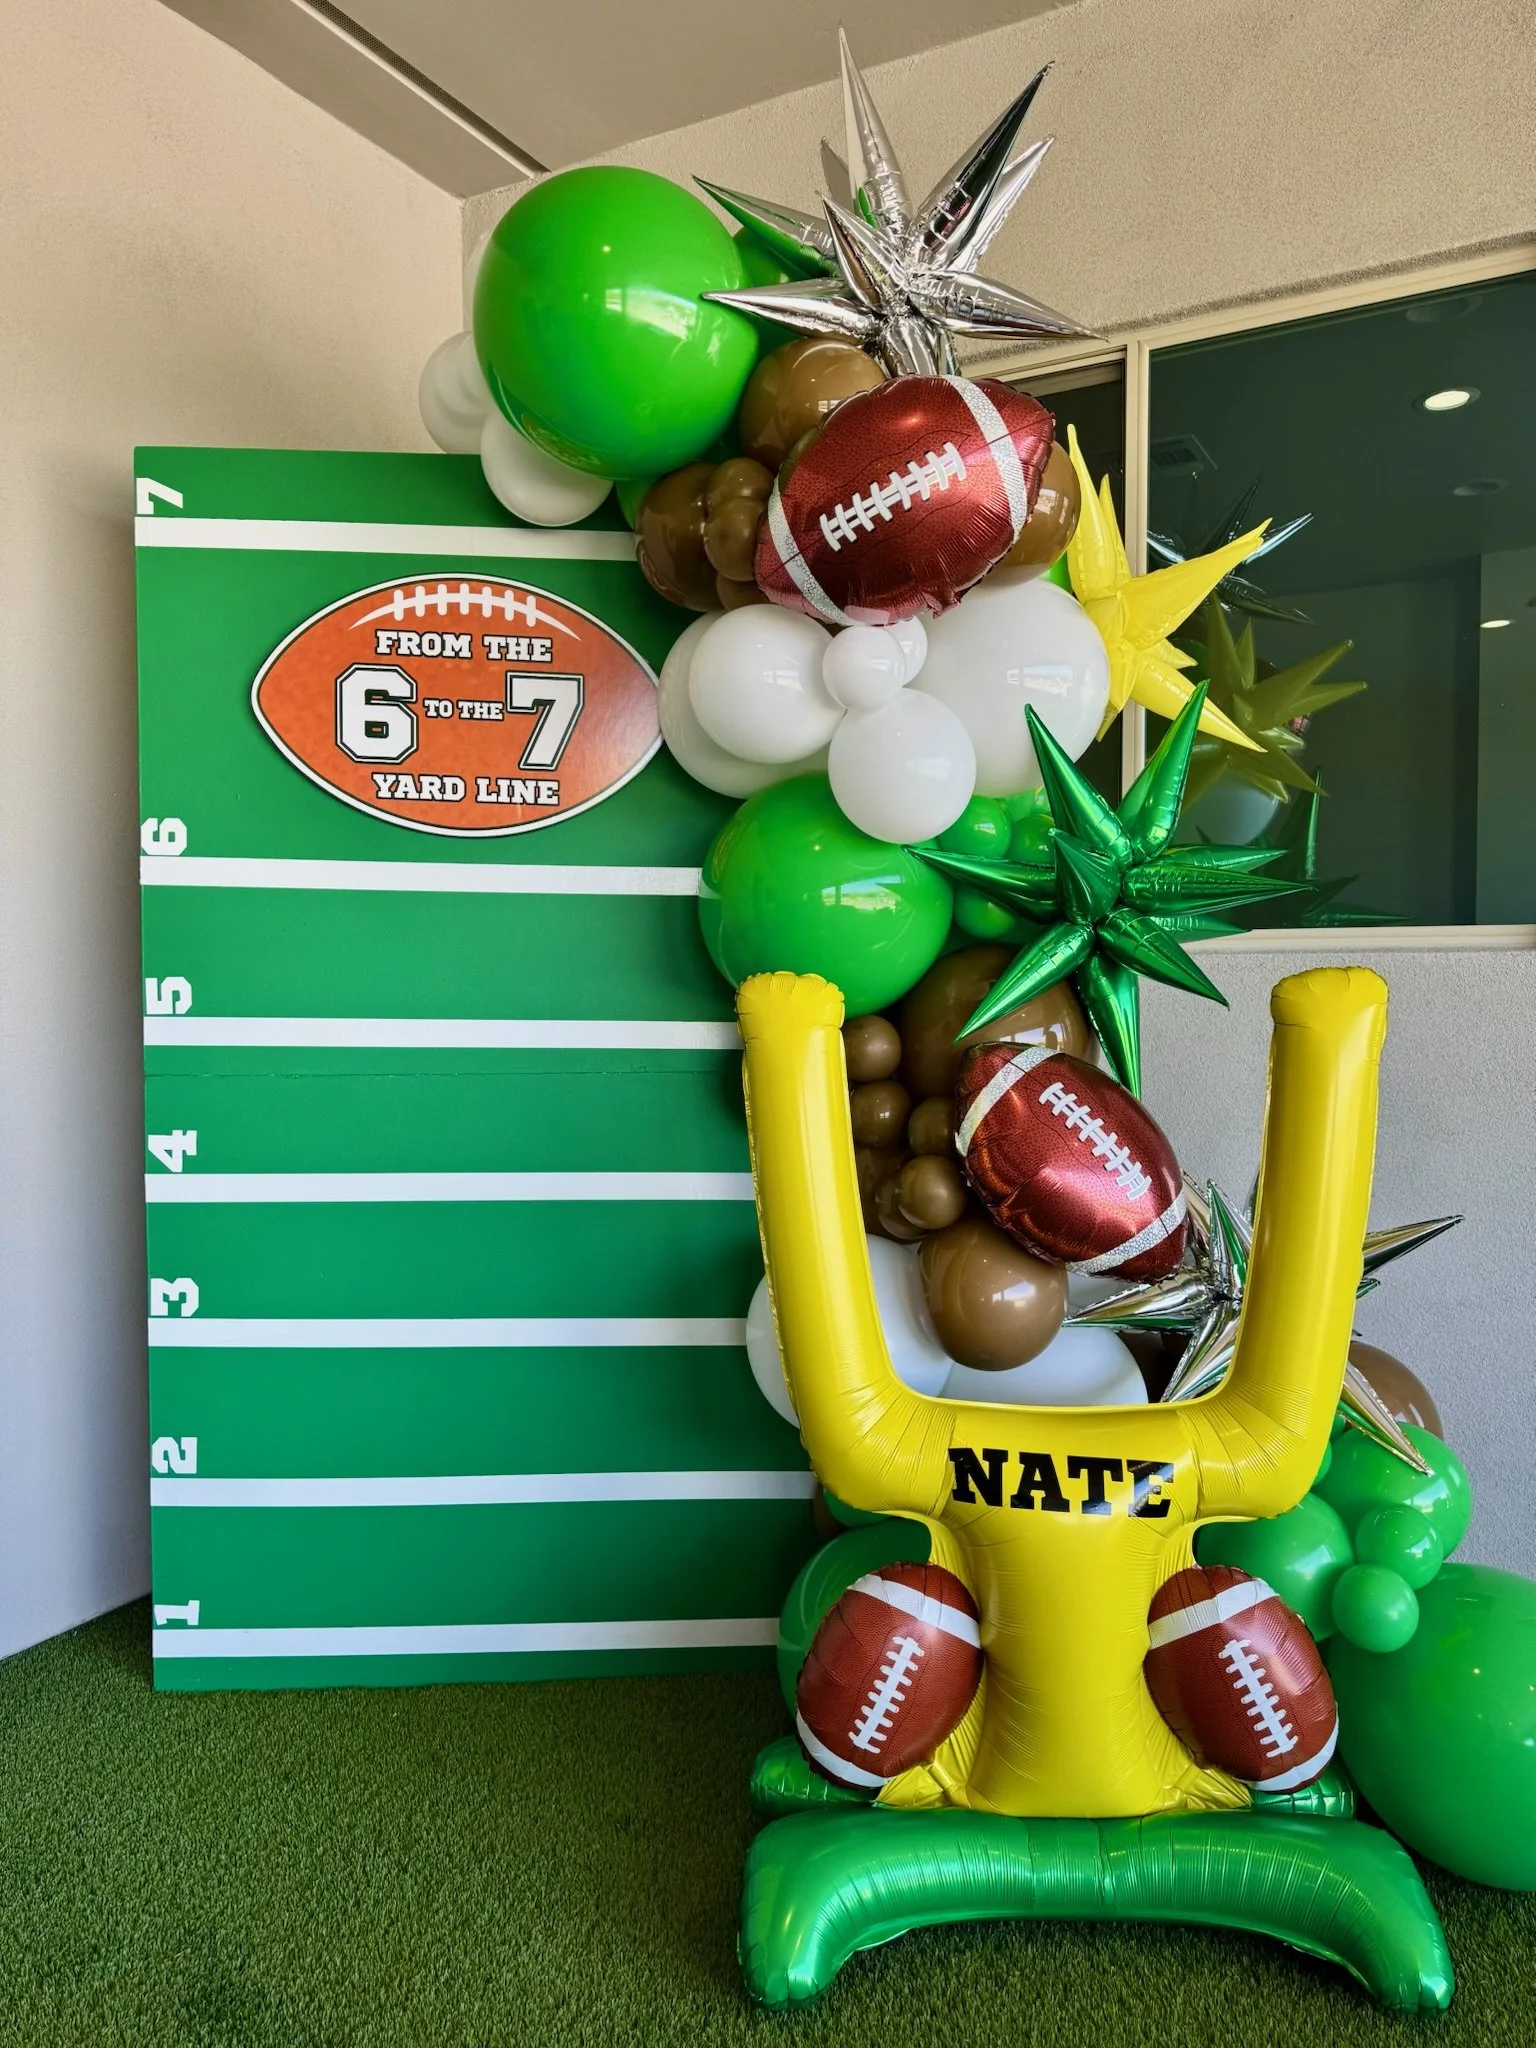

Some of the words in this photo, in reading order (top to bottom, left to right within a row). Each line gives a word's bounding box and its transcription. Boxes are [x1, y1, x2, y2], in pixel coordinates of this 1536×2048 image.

[136, 477, 184, 515] 7
[376, 630, 472, 659] FROM
[483, 634, 553, 663] THE
[335, 662, 418, 764] 6
[424, 699, 453, 719] TO
[457, 701, 504, 721] THE
[505, 670, 584, 771] 7
[372, 773, 466, 802] YARD
[476, 777, 560, 806] LINE
[140, 817, 188, 857] 6
[145, 976, 193, 1015] 5
[147, 1129, 197, 1173] 4
[150, 1277, 199, 1317] 3
[151, 1436, 197, 1474] 2
[948, 1447, 1174, 1519] NATE
[153, 1600, 200, 1626] 1
